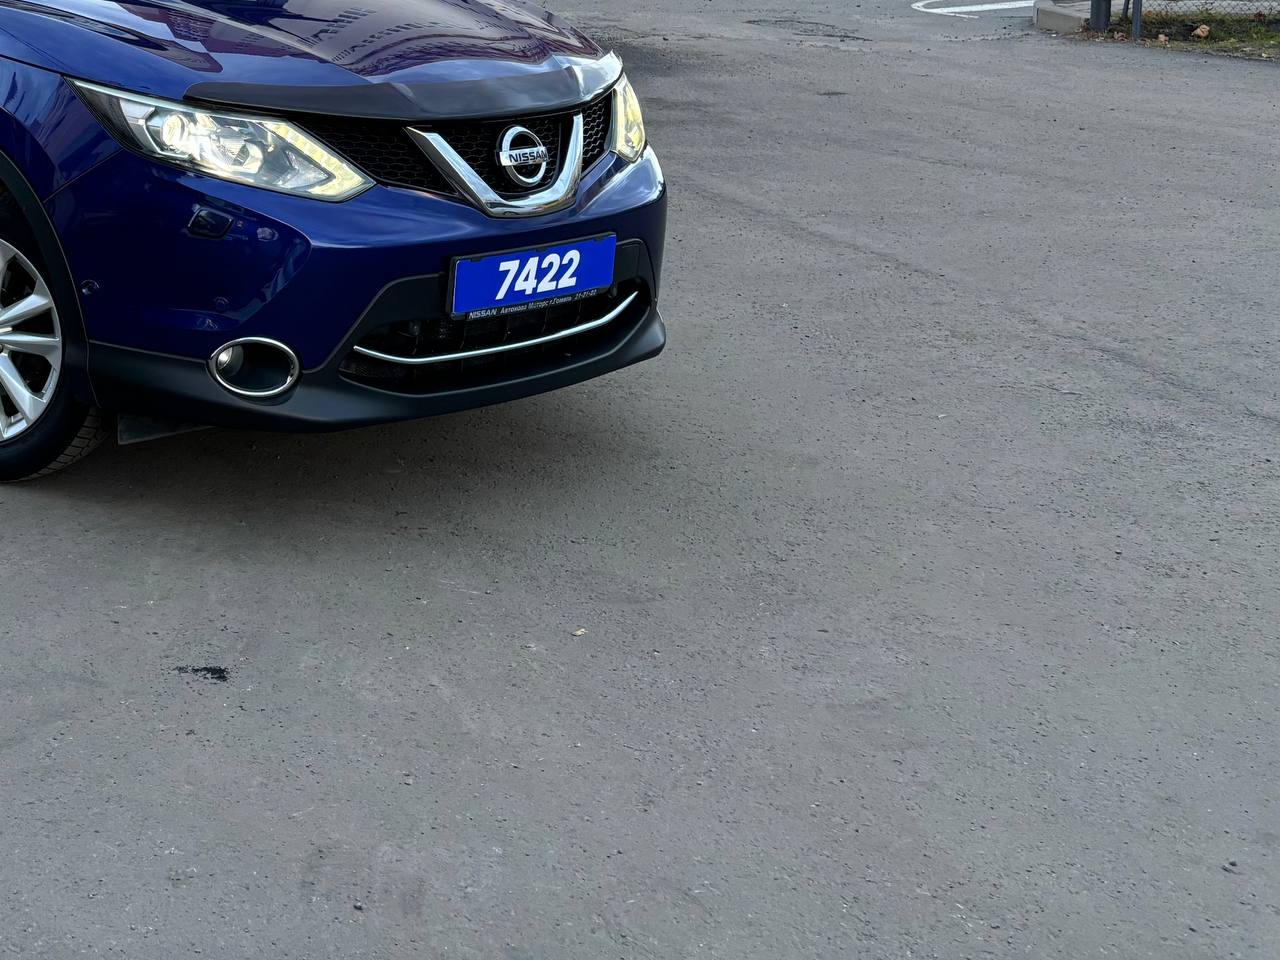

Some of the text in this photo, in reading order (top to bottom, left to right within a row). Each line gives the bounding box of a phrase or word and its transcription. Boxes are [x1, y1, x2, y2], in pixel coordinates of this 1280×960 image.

[509, 149, 548, 163] NISSAN
[495, 249, 581, 300] 7422
[468, 308, 497, 319] NISSAN
